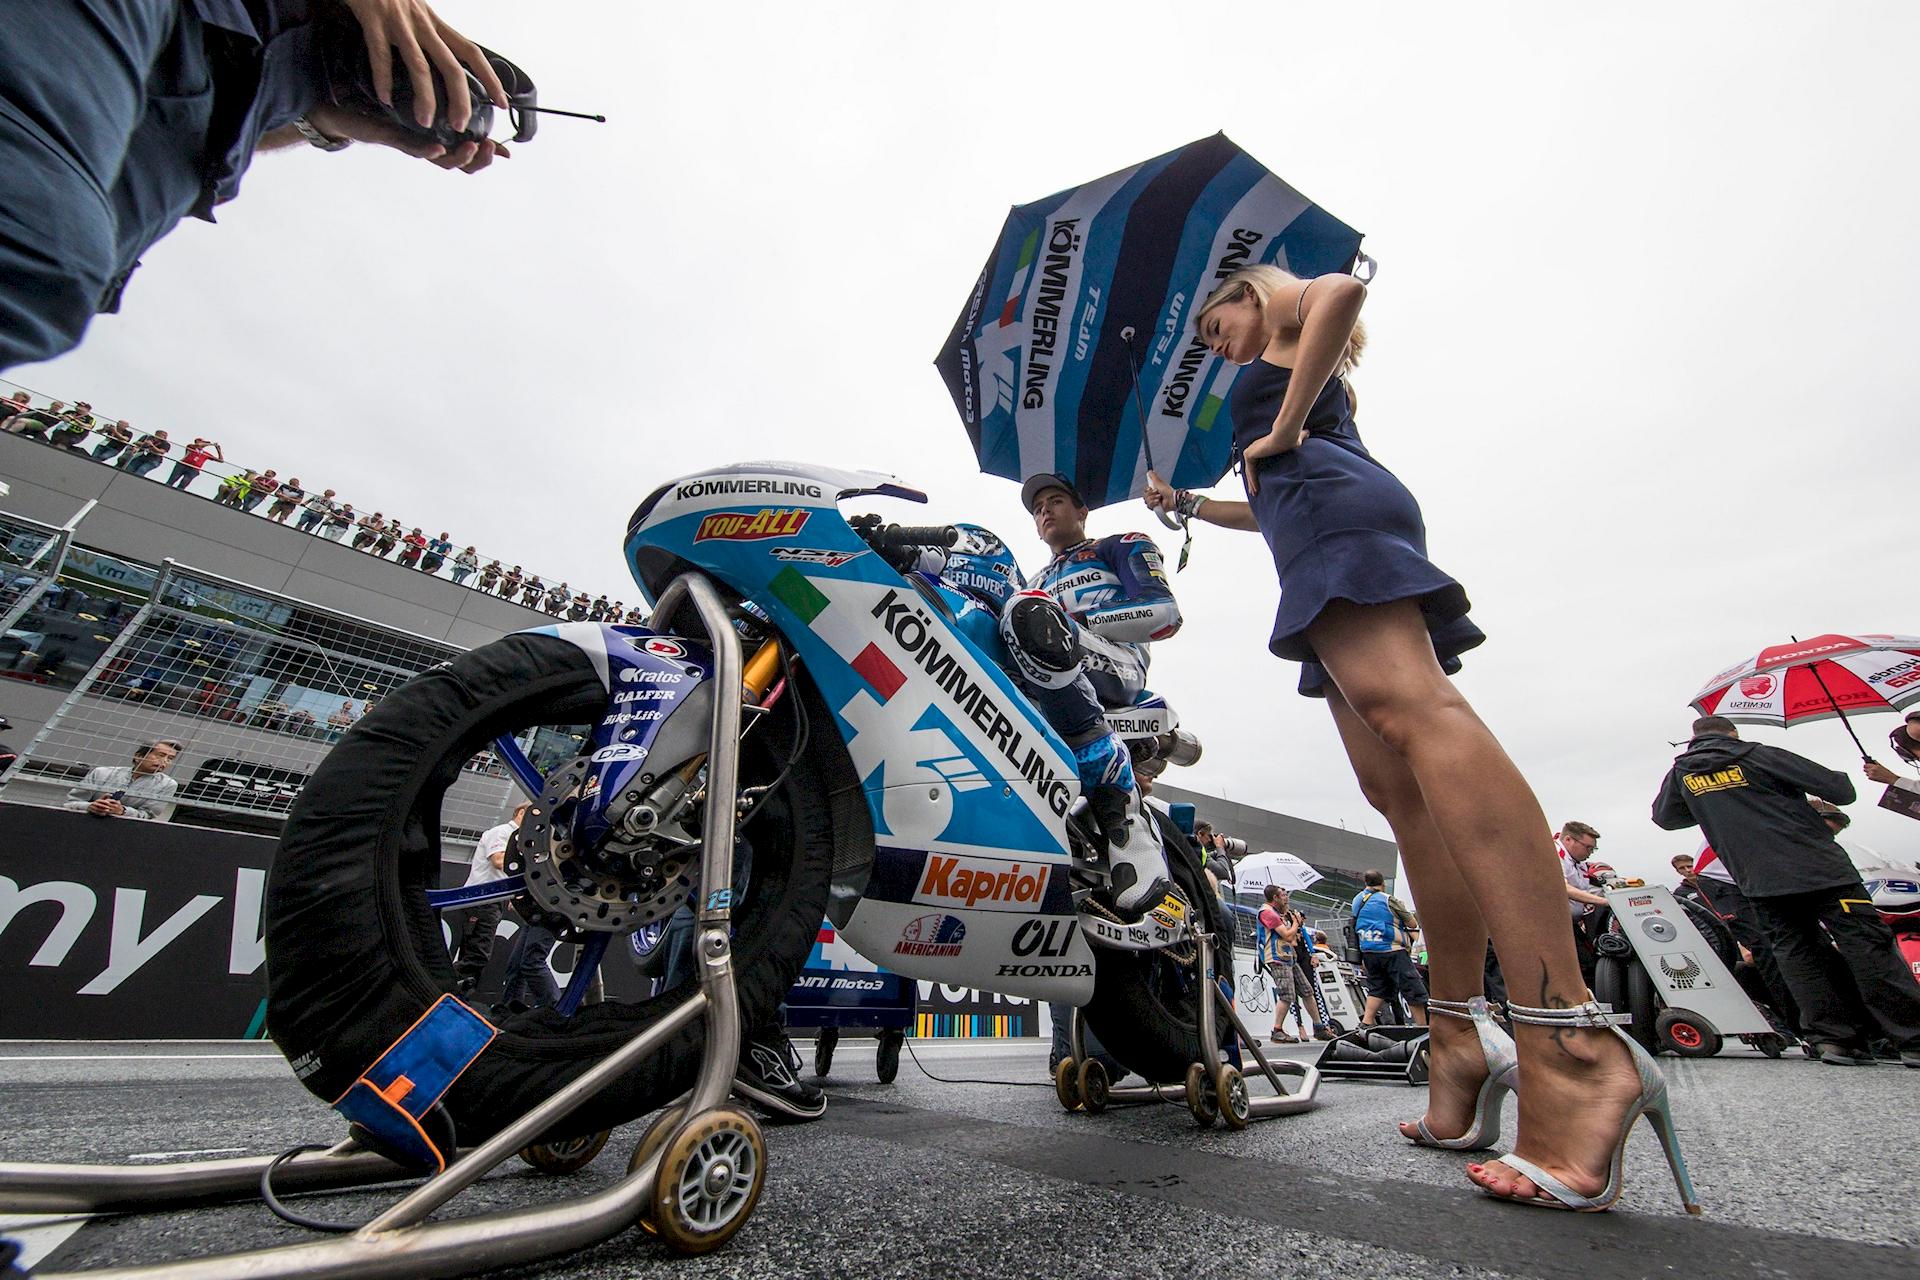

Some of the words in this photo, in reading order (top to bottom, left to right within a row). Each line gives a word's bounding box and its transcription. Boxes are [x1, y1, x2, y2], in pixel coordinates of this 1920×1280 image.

[1024, 218, 1081, 409] KÖMMERLING
[1074, 286, 1101, 361] TEAM
[1152, 291, 1185, 366] TEAM
[677, 479, 821, 500] KÖMMERLING
[701, 509, 802, 538] YOU-ALL
[971, 573, 1006, 598] LOVERS
[1763, 642, 1853, 663] HONDA
[620, 668, 683, 683] Kratos
[614, 690, 676, 704] GALFER
[871, 589, 1070, 819] KÖMMERLING
[602, 710, 663, 726] Bike-Lift
[1685, 769, 1743, 790] ÖHLINS
[921, 856, 1048, 907] Kapriol
[1128, 927, 1150, 943] NGK
[1155, 926, 1169, 943] 2D
[894, 941, 963, 957] AMERICANINO
[995, 964, 1094, 977] HONDA
